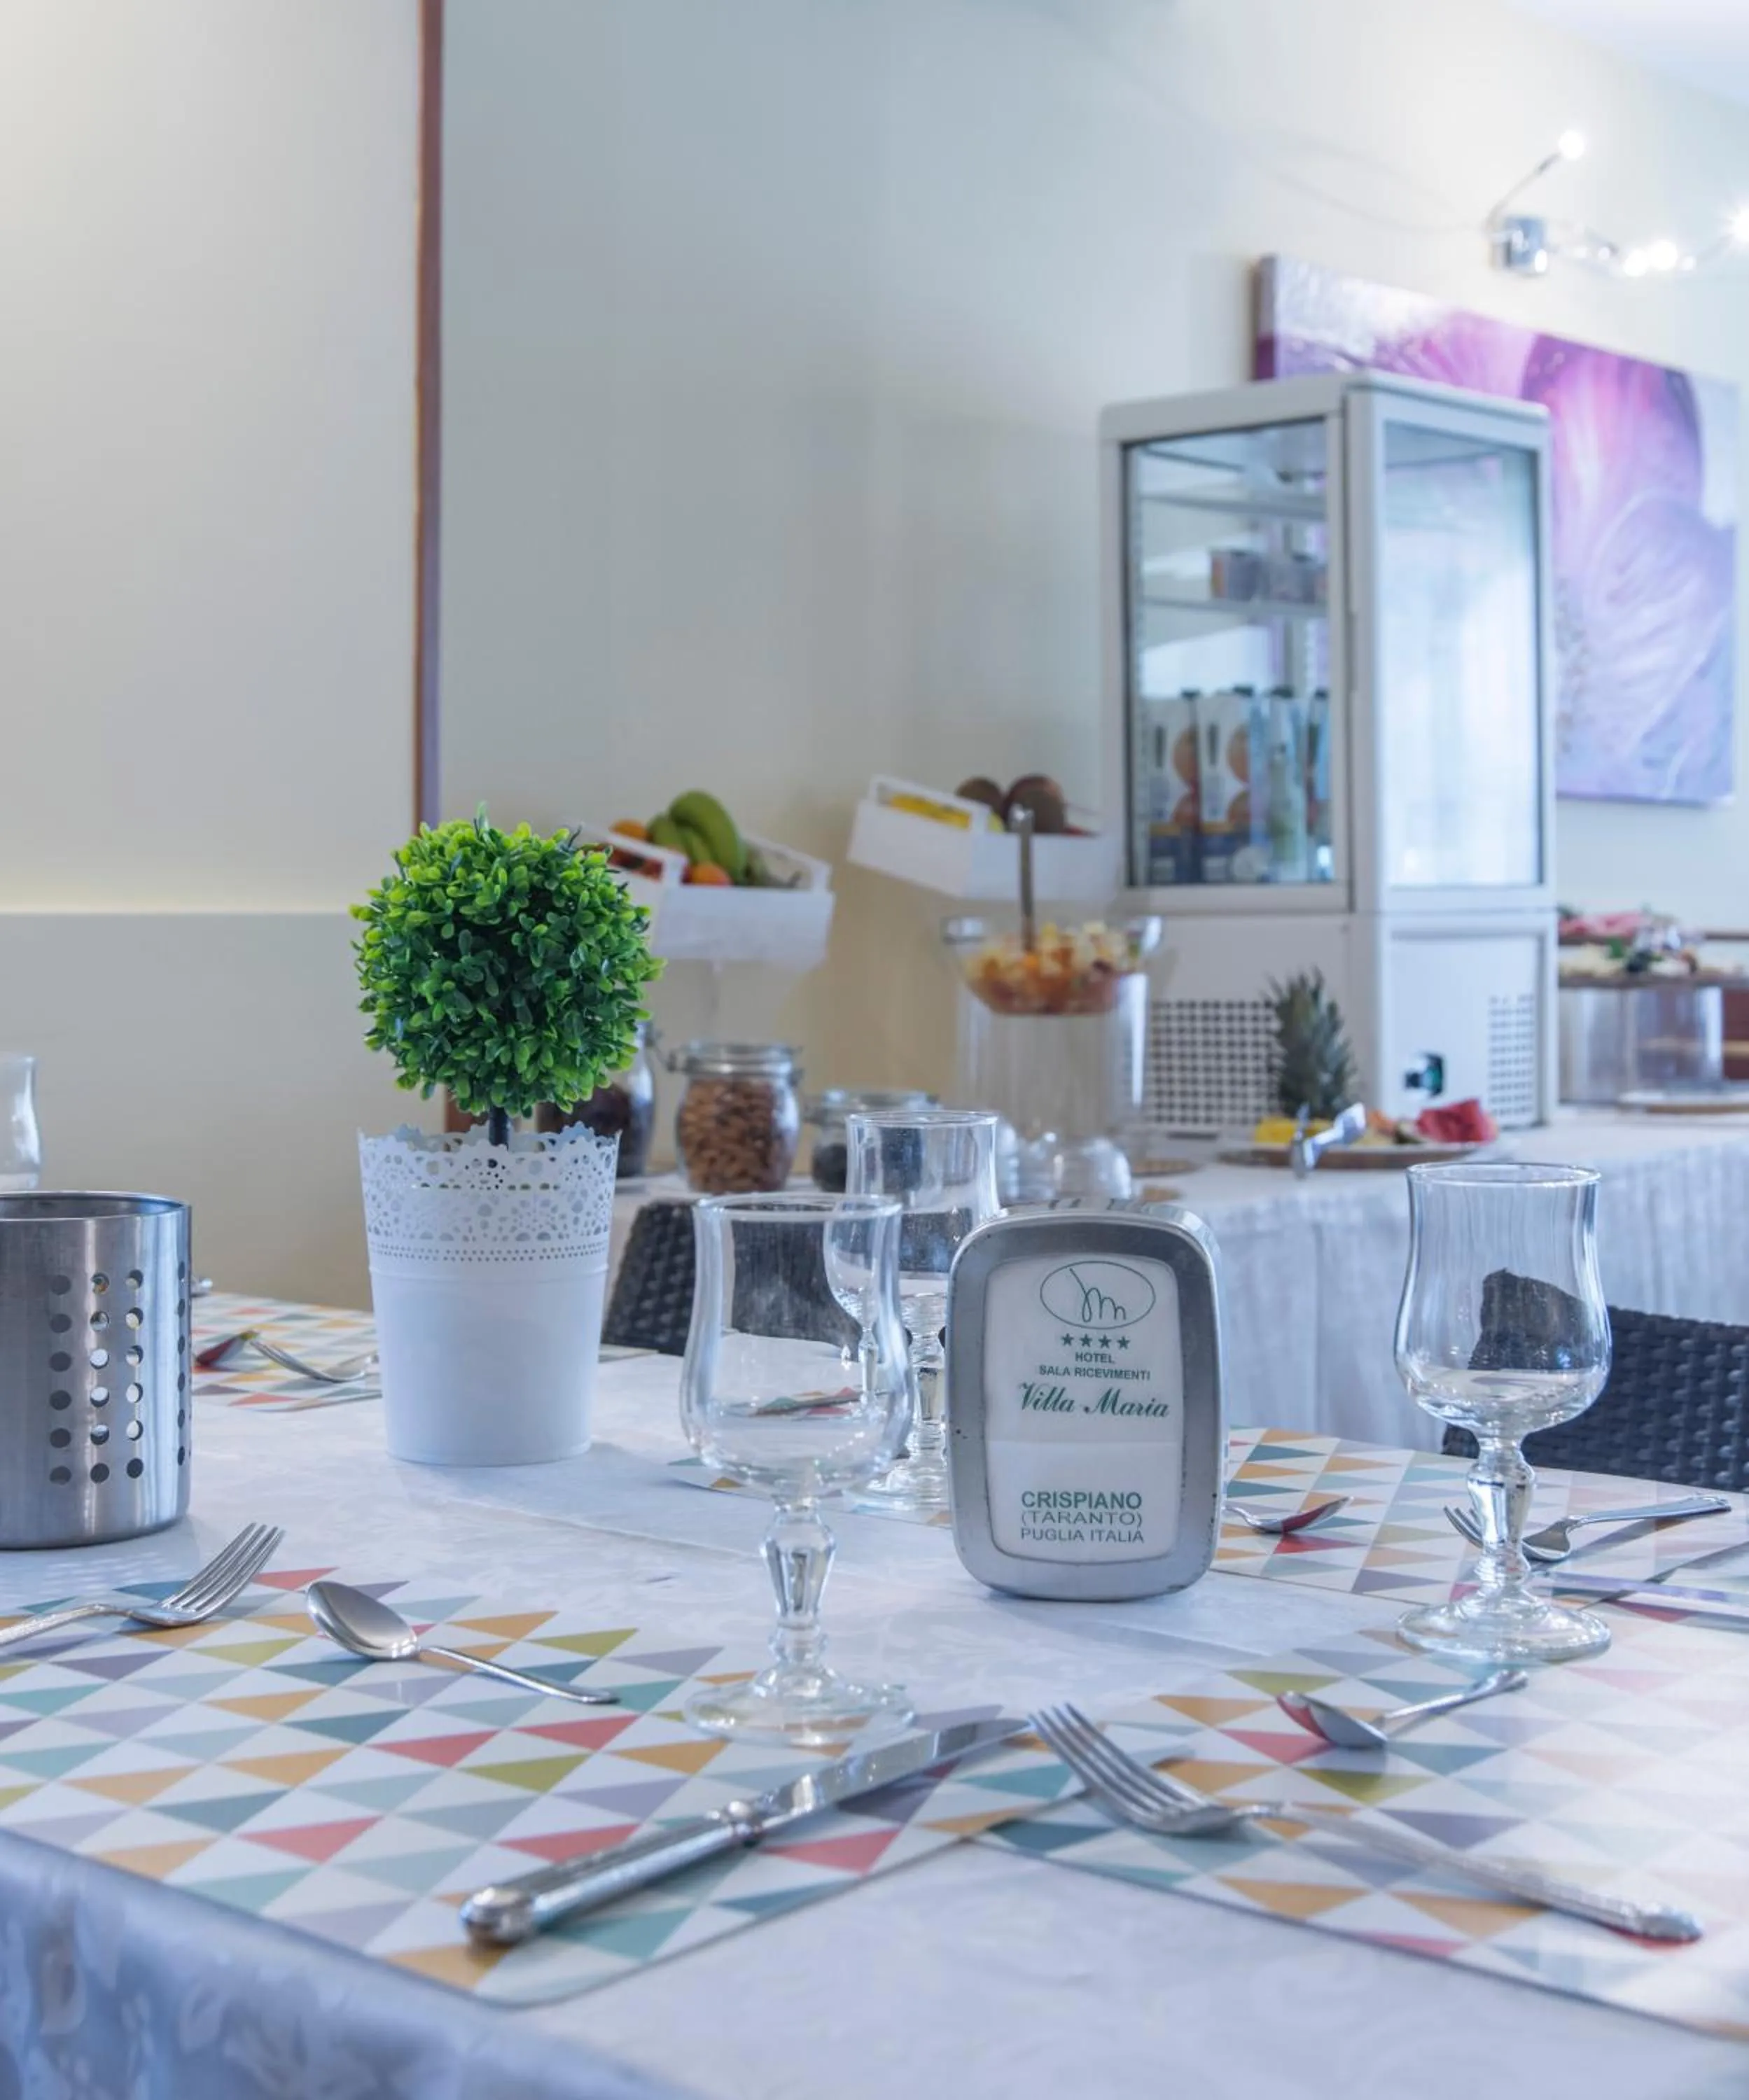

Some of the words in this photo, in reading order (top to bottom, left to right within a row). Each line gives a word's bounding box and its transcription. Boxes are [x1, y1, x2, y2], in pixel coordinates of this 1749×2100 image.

[1075, 1352, 1115, 1364] HOTEL
[1039, 1365, 1071, 1377] SALA
[1074, 1366, 1150, 1380] RICEVIMENTI
[1019, 1382, 1075, 1413] Villa
[1083, 1387, 1171, 1418] Maria
[1021, 1491, 1143, 1509] CRISPIANO
[1021, 1510, 1143, 1529] (TARANTO)
[1021, 1527, 1085, 1542] PUGLIA
[1090, 1529, 1144, 1544] ITALIA
